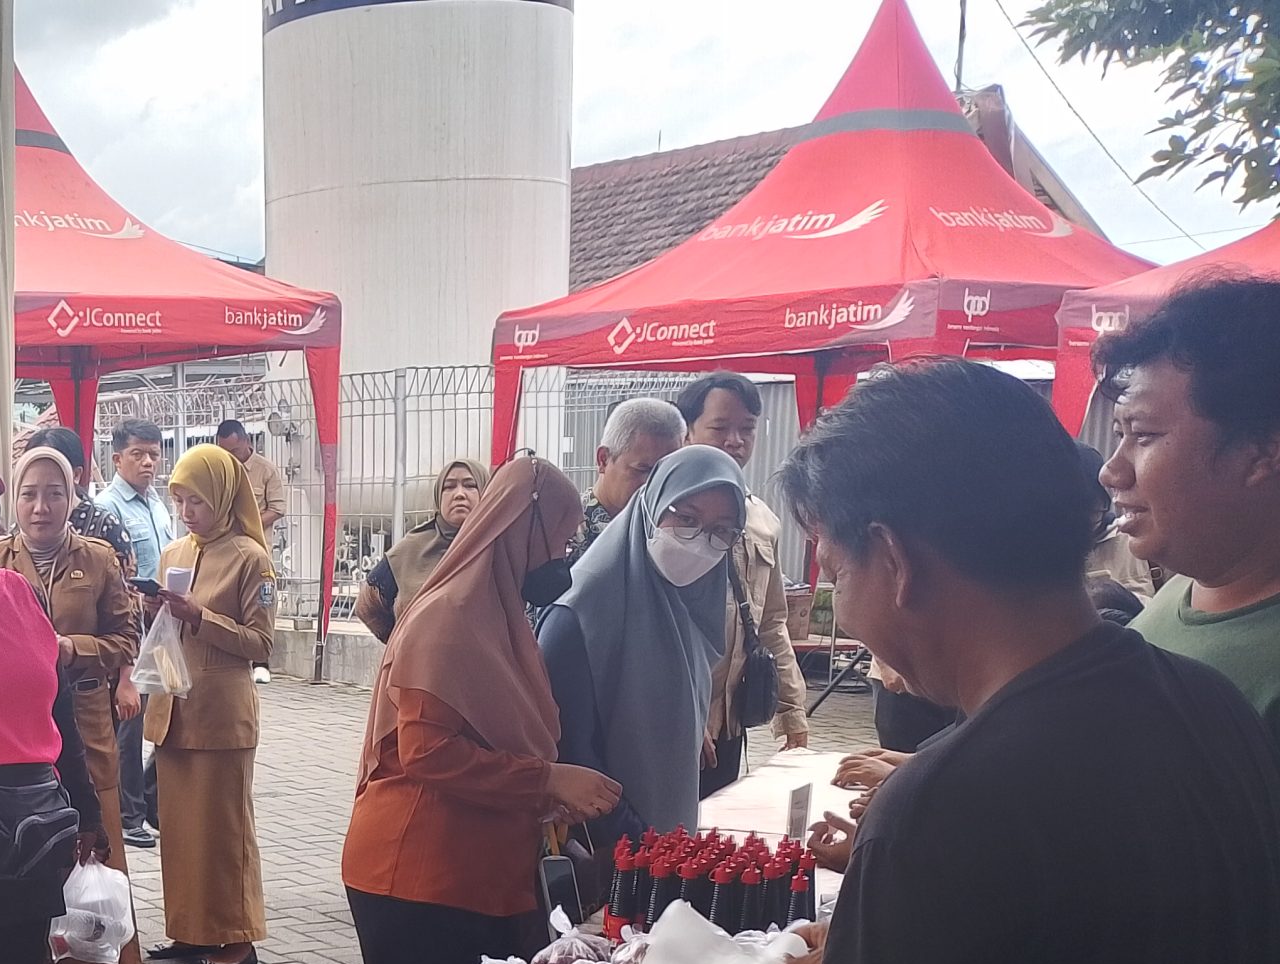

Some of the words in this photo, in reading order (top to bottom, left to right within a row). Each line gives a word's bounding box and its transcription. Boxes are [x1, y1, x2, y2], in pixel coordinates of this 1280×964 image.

[697, 210, 835, 242] bankjatim
[929, 206, 1046, 232] bankjatim
[82, 308, 162, 327] JConnect
[224, 306, 303, 330] bankjatim
[784, 300, 882, 329] bankjatim
[636, 320, 716, 342] JConnect
